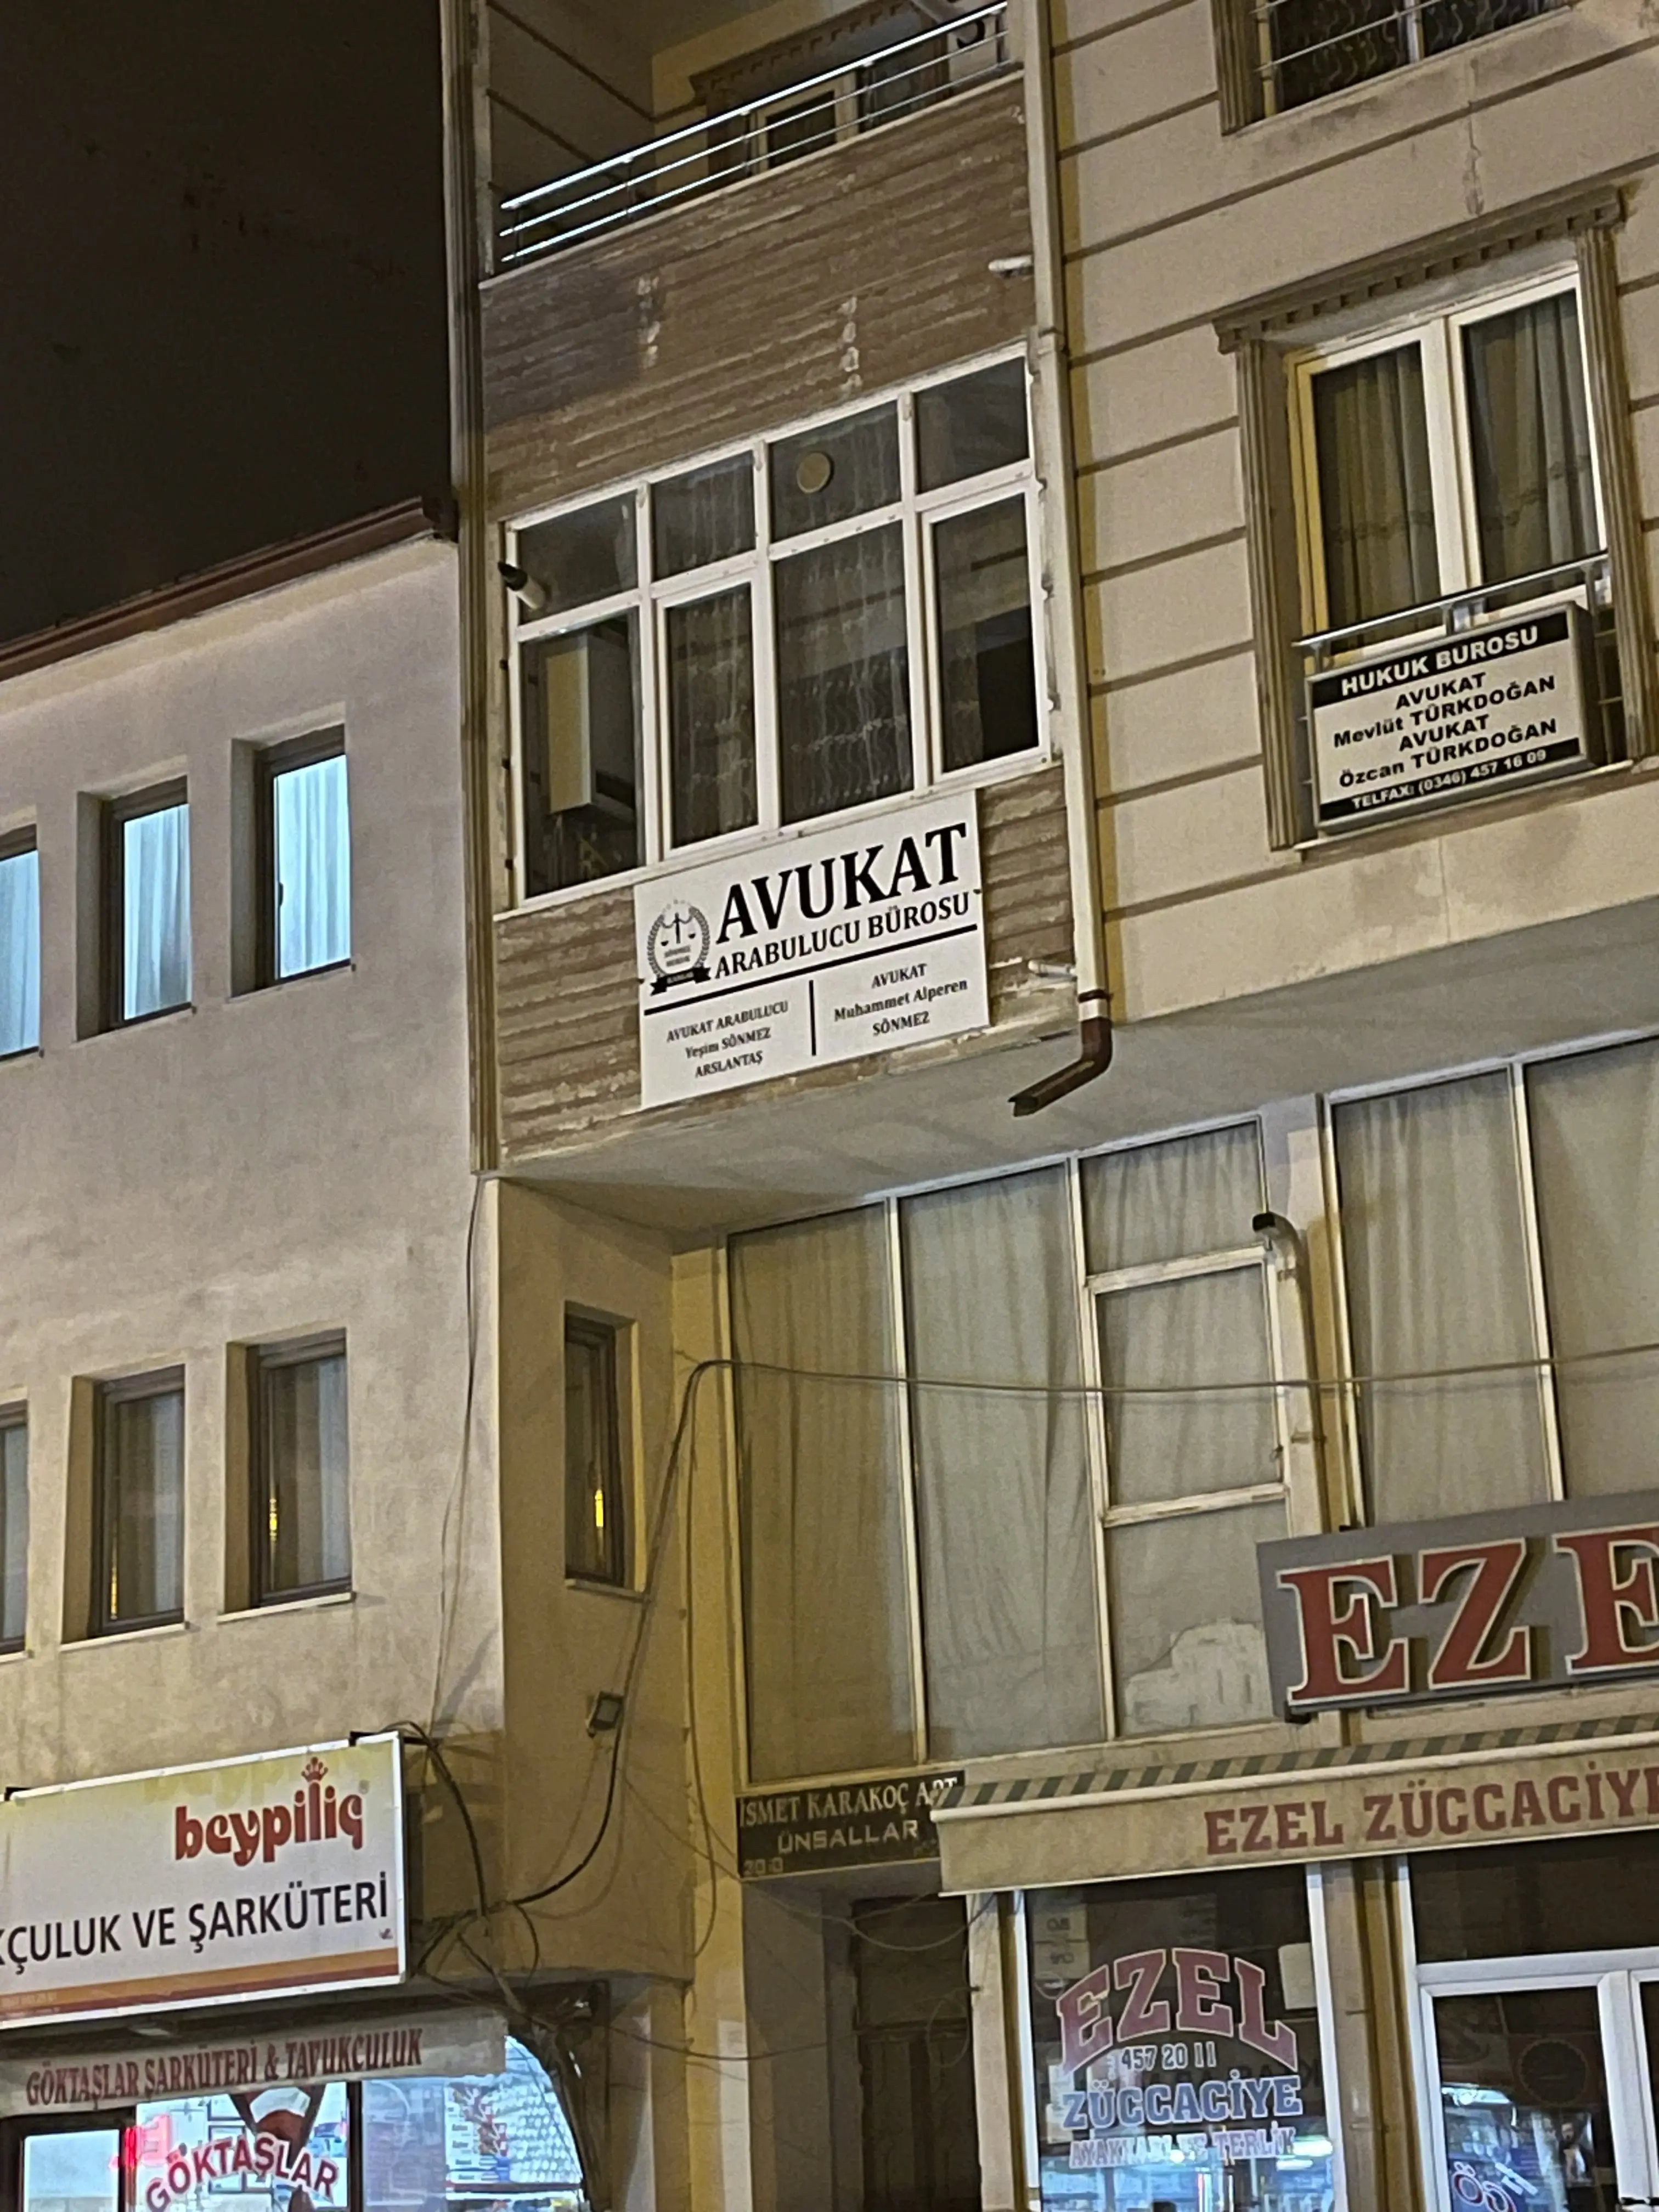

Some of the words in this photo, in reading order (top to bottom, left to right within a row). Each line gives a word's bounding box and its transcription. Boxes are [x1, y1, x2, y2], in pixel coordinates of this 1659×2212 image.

[1341, 656, 1429, 696] HUKUK
[1395, 672, 1486, 710] AVUKAT
[1334, 716, 1404, 748] Mevlüt
[1410, 675, 1555, 726] TÜRKDOĞAN
[1399, 714, 1490, 752] AVUKAT
[1339, 762, 1404, 787] Özcan
[1410, 718, 1557, 769] TÜRKDOĞAN
[1470, 761, 1498, 778] 457
[715, 822, 967, 944] AVUKAT
[715, 920, 860, 979] ARABULUCU
[868, 891, 969, 938] BÜROSU
[871, 963, 927, 989] AVUKAT
[667, 1019, 714, 1042] AVUKAT
[715, 1001, 789, 1030] ARABULUCU
[834, 992, 910, 1022] Muhammet
[913, 979, 968, 1002] Alperen
[721, 1027, 771, 1050] SÖNMEZ
[872, 1011, 930, 1036] SÖNMEZ
[695, 1050, 763, 1078] ARSLANTAŞ
[808, 1783, 909, 1820] KARAKOÇ
[175, 1782, 363, 1866] beypiliç
[1204, 1801, 1344, 1855] EZEL
[0, 1914, 122, 1976] ÇULUK
[133, 1907, 176, 1948] VE
[189, 1871, 387, 1953] ŞARKÜTERİ
[1057, 1947, 1298, 2074] EZEL
[26, 2061, 139, 2108] GÖKTAŞLAR
[144, 2038, 257, 2098] ŞARKÜTERİ
[264, 2042, 279, 2081] &
[1121, 2045, 1156, 2070] 457
[1163, 2042, 1187, 2070] 20
[1063, 2069, 1303, 2129] ZÜCCACİYE
[146, 2134, 339, 2212] GÖKTAŞLAR
